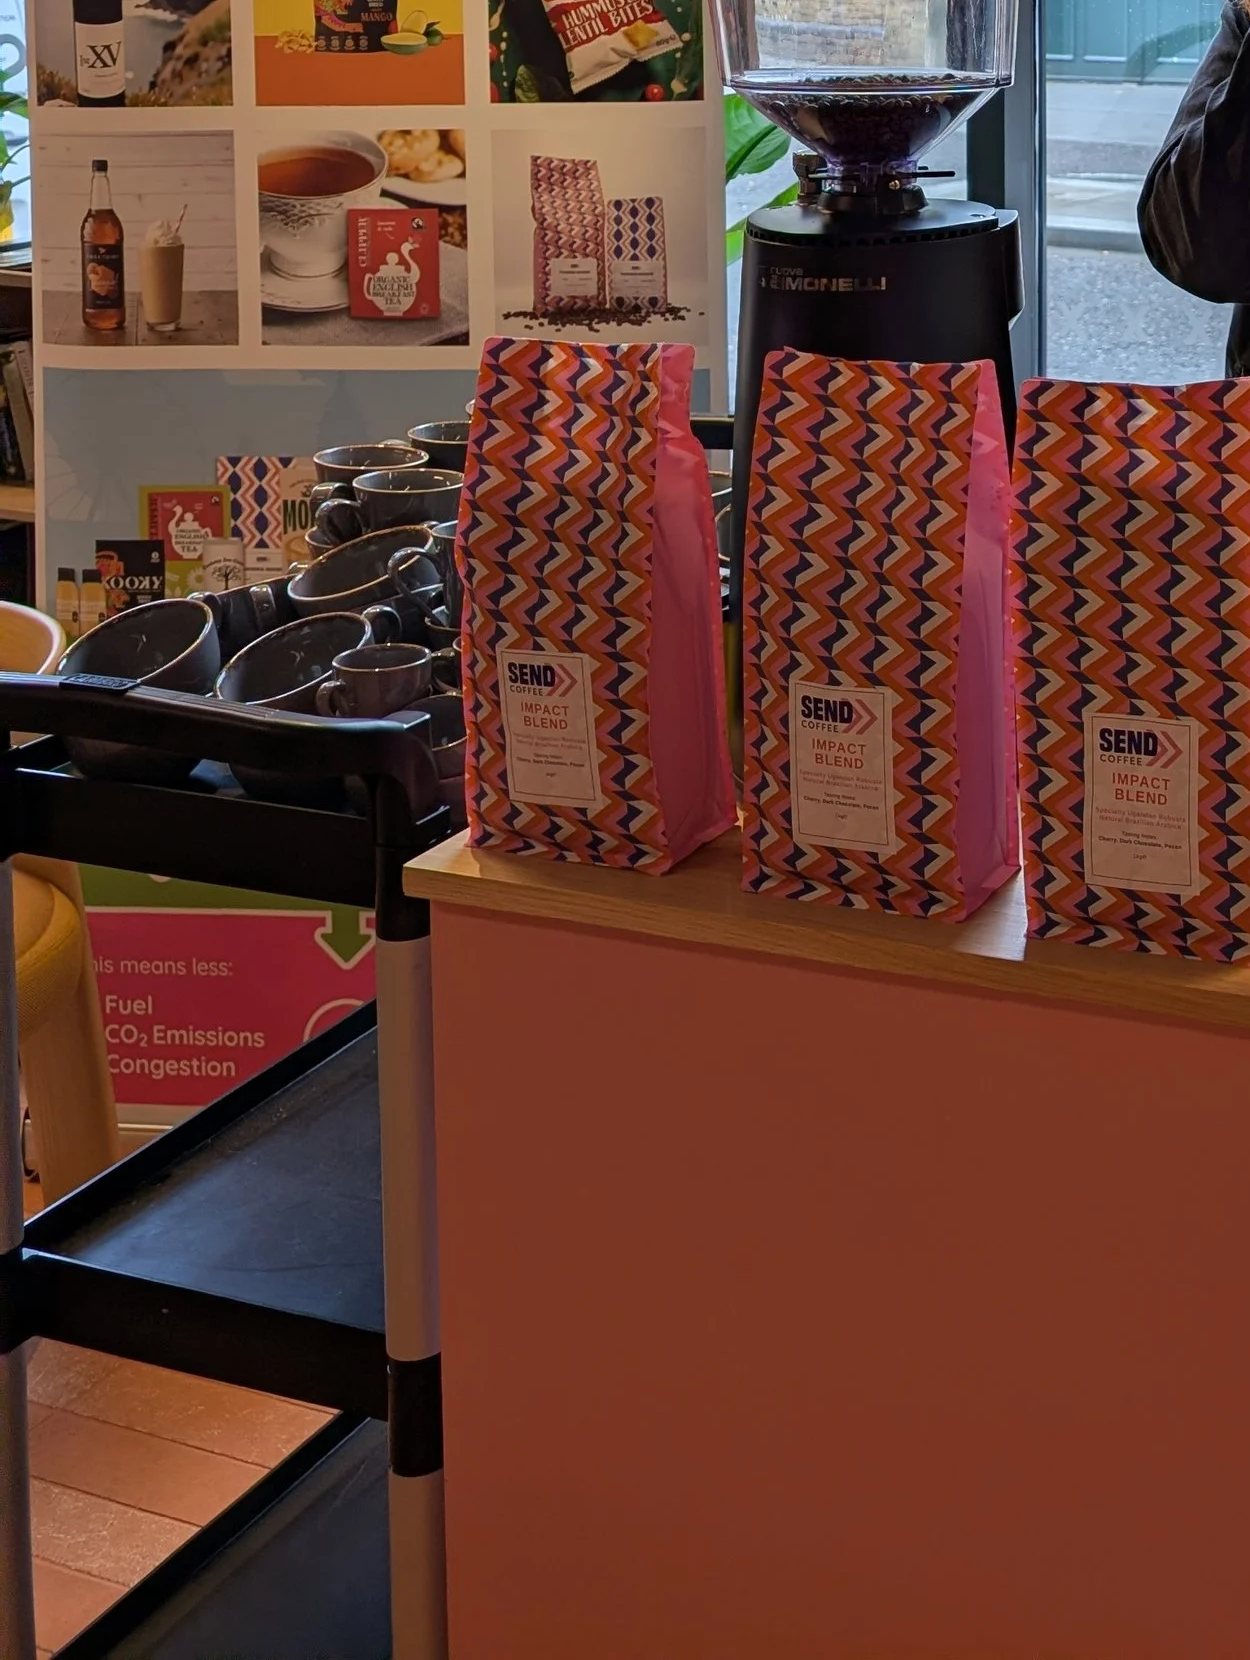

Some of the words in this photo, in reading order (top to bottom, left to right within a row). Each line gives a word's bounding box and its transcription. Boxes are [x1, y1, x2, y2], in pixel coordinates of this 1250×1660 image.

[360, 12, 393, 22] MANGO
[557, 19, 609, 48] LENTIL
[86, 41, 122, 69] XV
[372, 283, 413, 291] ENGLISH
[507, 662, 556, 688] SEND
[509, 685, 544, 697] COFFEE
[520, 701, 570, 717] IMPACT
[801, 695, 854, 724] SEND
[523, 716, 568, 730] BLEND
[801, 720, 839, 733] COFFEE
[811, 738, 867, 756] IMPACT
[1099, 728, 1159, 757] SEND
[815, 753, 864, 769] BLEND
[1100, 754, 1143, 766] COFFEE
[1112, 772, 1171, 791] IMPACT
[1115, 788, 1168, 806] BLEND
[92, 956, 114, 973] his
[120, 959, 187, 975] means
[192, 958, 233, 976] less:
[105, 995, 153, 1015] Fuel
[153, 1025, 265, 1048] Emissions
[107, 1053, 236, 1079] Congestion
